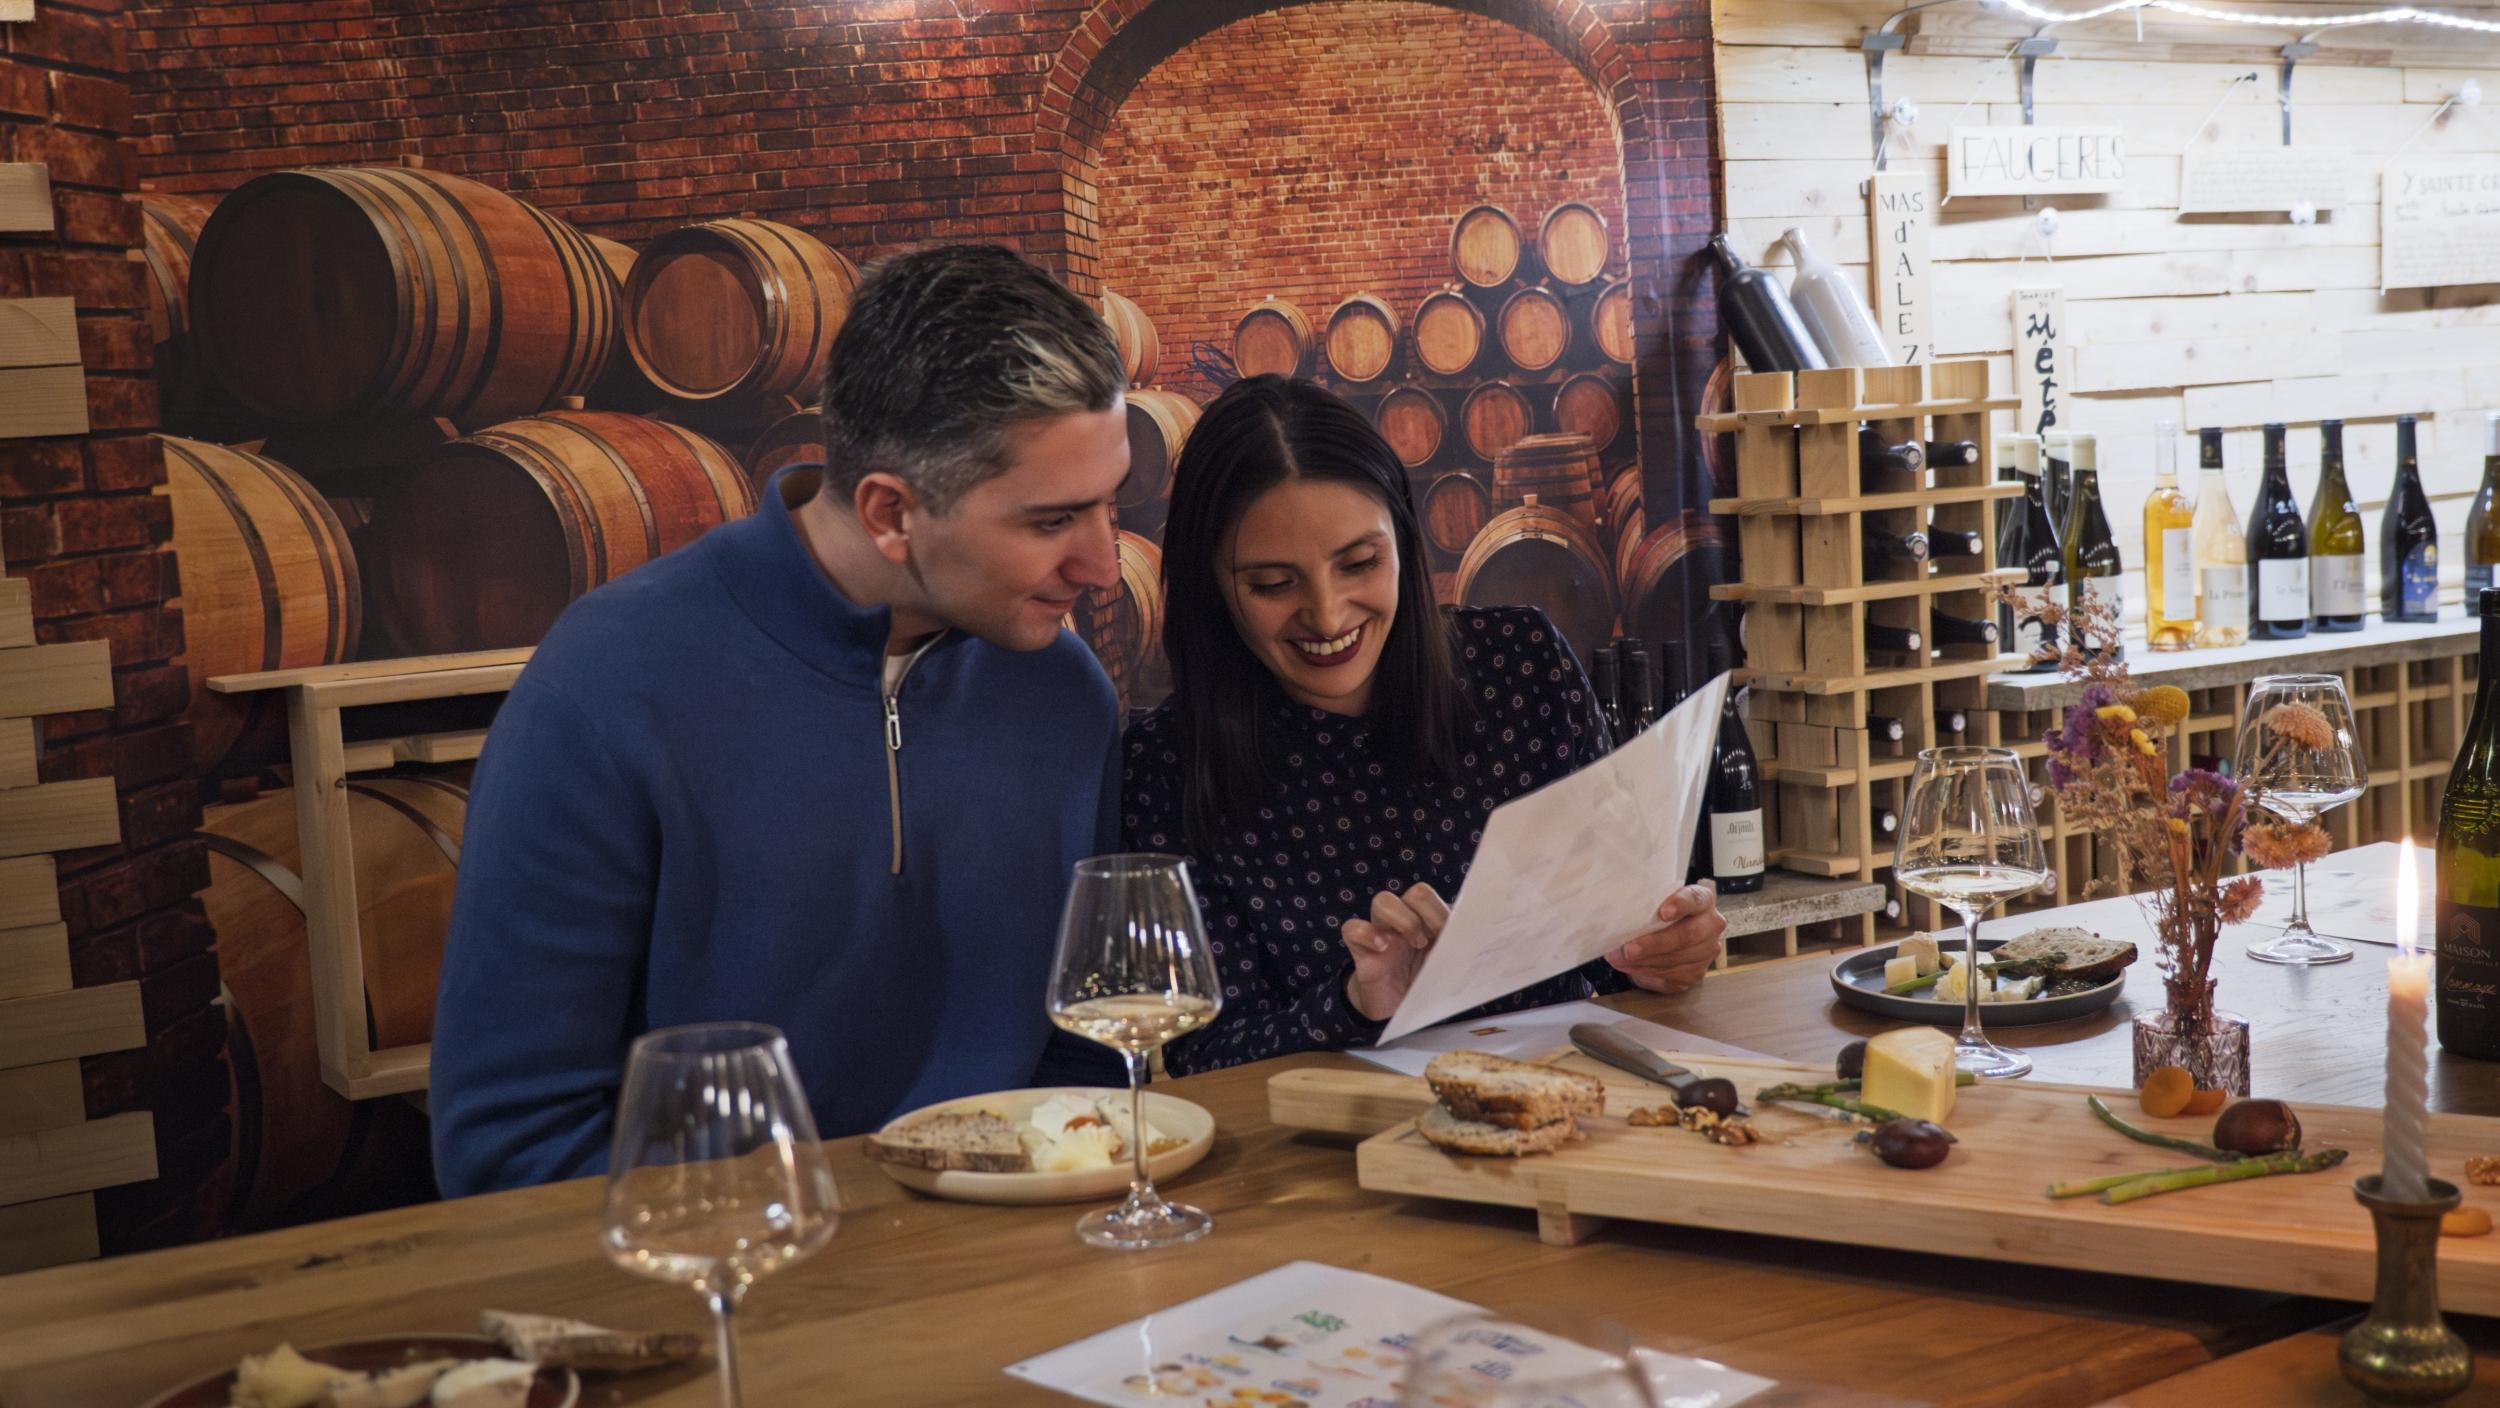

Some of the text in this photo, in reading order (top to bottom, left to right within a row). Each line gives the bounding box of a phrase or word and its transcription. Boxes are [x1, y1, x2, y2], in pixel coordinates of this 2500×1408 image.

[1960, 134, 2126, 183] FAUGERES
[1879, 191, 1924, 213] MAS
[2443, 942, 2492, 959] MAISON
